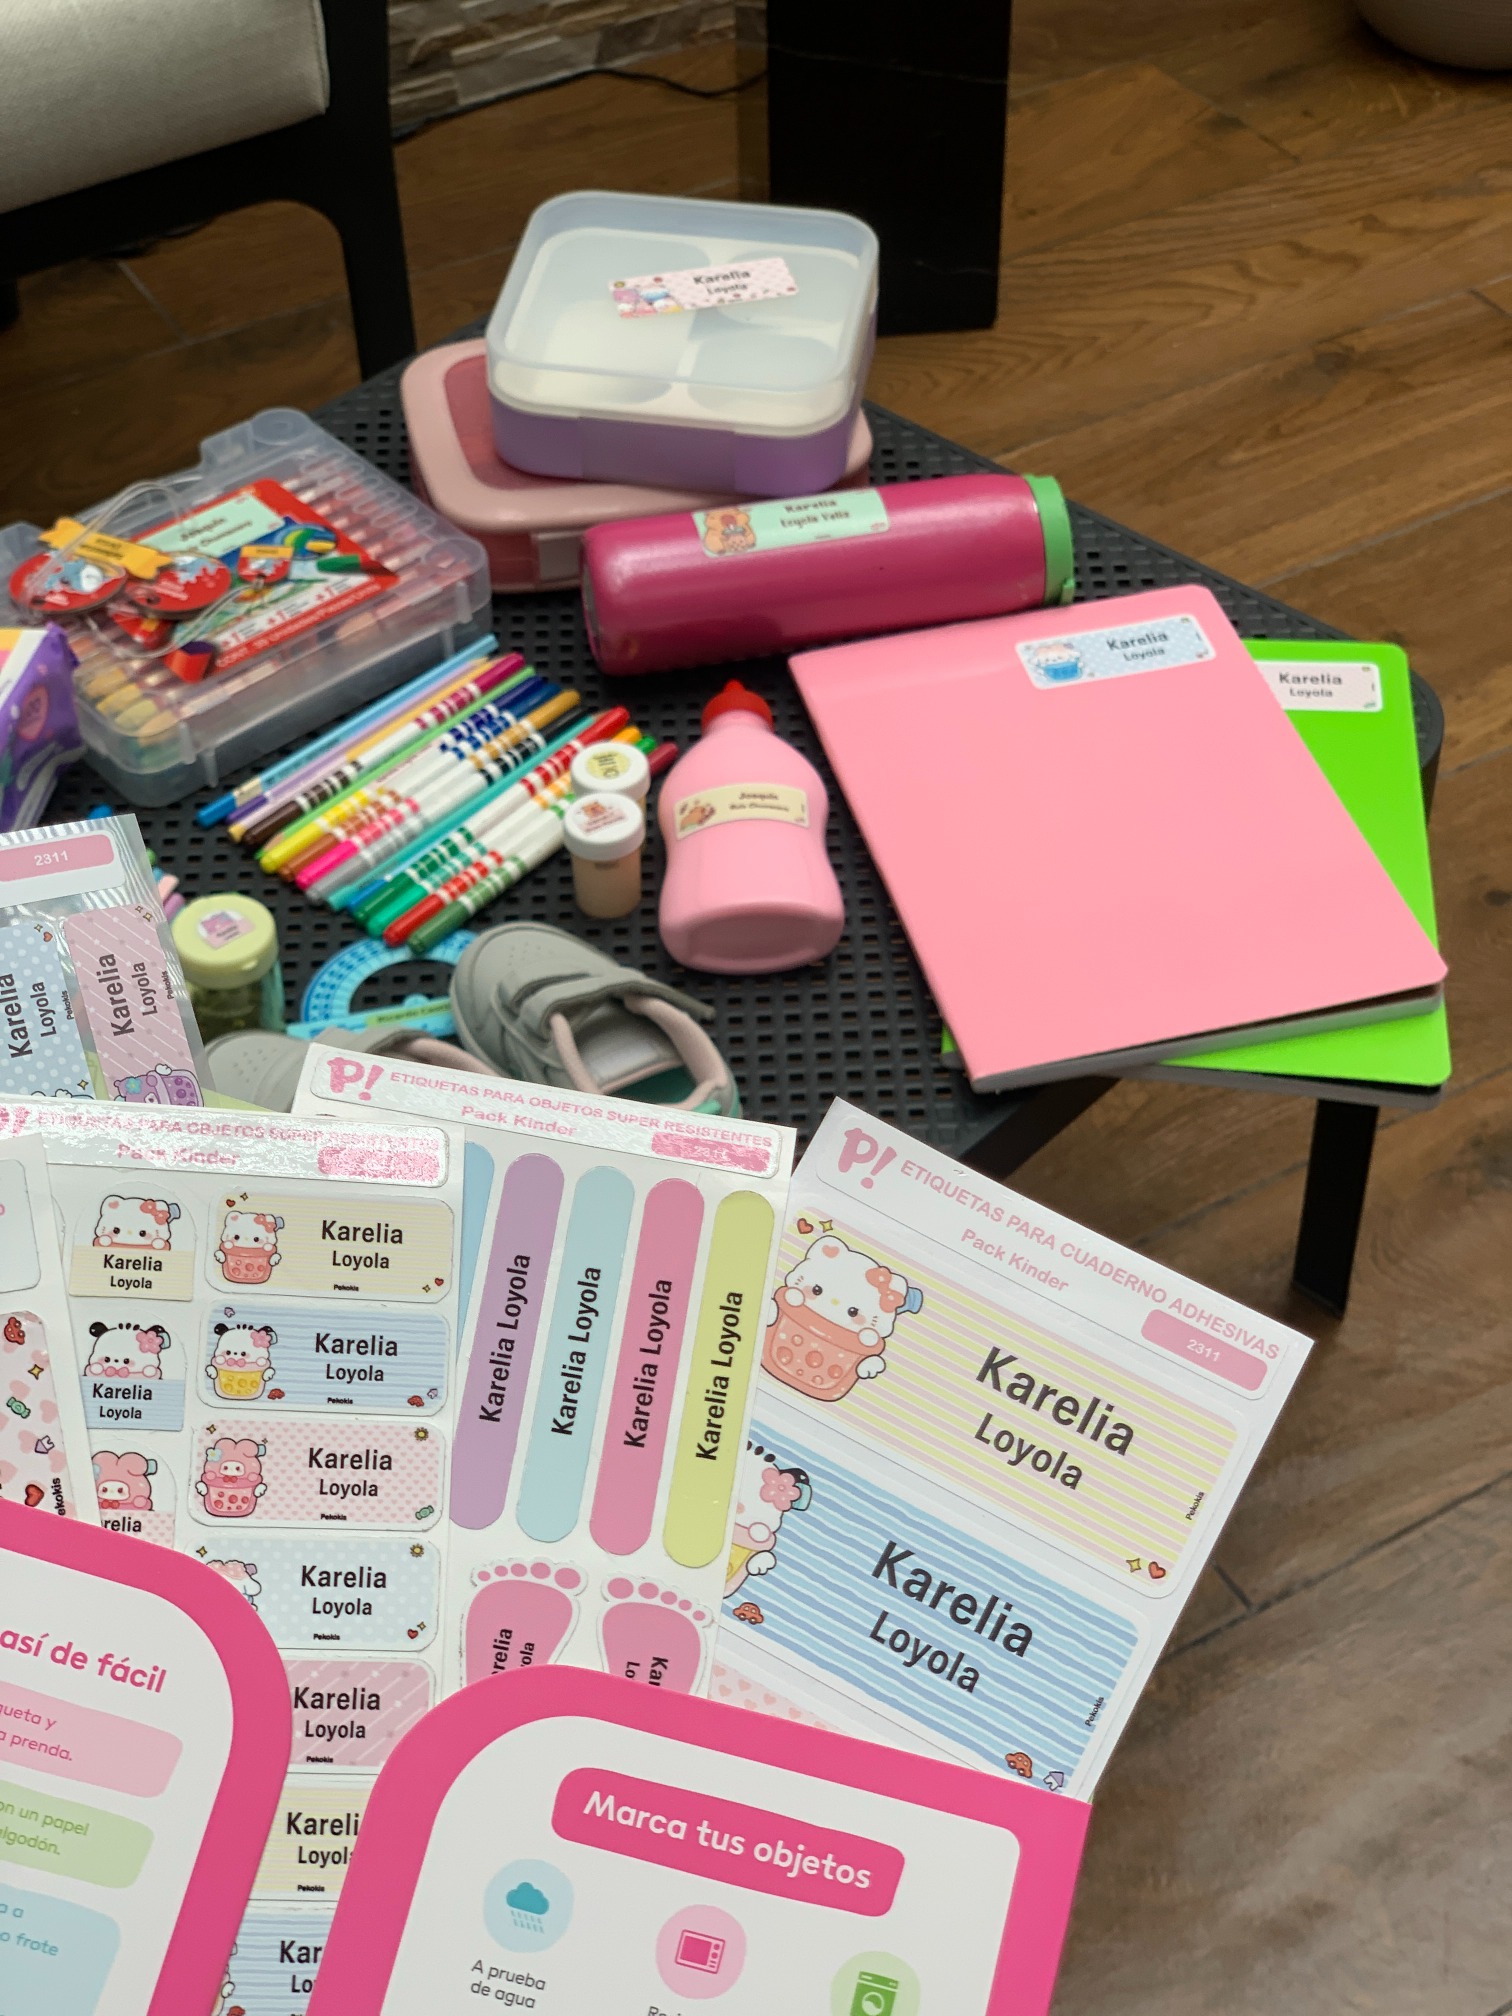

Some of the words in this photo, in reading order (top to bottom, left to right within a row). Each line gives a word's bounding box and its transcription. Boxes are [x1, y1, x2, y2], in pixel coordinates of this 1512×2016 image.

[1107, 629, 1169, 651] Karelia
[1123, 645, 1166, 662] Loyola
[1279, 671, 1343, 686] Karelia
[1289, 688, 1334, 698] Loyola
[34, 850, 69, 867] 2311
[98, 953, 135, 1037] Karelia
[131, 962, 158, 1016] Loyola
[161, 971, 175, 1000] Pekokis
[0, 974, 33, 1058] Karelia
[30, 982, 57, 1037] Loyola
[62, 990, 74, 1020] Pekokis
[390, 1071, 479, 1096] ETIQUETAS
[483, 1088, 525, 1106] PARA
[529, 1095, 603, 1118] OBJETOS
[607, 1107, 660, 1129] SUPER
[664, 1120, 773, 1147] RESISTENTES
[460, 1105, 508, 1123] Pack
[513, 1114, 578, 1137] Kinder
[187, 1121, 265, 1138] OBJETOS
[837, 1127, 898, 1190] P!
[321, 1219, 403, 1244] Karelia
[103, 1254, 163, 1272] Karelia
[332, 1250, 390, 1271] Loyola
[900, 1159, 1005, 1224] ETIQUETAS
[1006, 1214, 1057, 1251] PARA
[1059, 1242, 1168, 1305] CUADERNO
[1168, 1296, 1281, 1361] ADHESIVAS
[960, 1228, 1004, 1262] Pack
[1008, 1249, 1070, 1293] Kinder
[110, 1276, 153, 1290] Loyola
[496, 1254, 531, 1330] Loyola
[568, 1266, 602, 1343] Loyola
[639, 1279, 673, 1355] Loyola
[711, 1291, 743, 1368] Loyola
[315, 1333, 398, 1357] Karelia
[1186, 1338, 1221, 1363] 2311
[325, 1363, 384, 1383] Loyola
[478, 1337, 516, 1423] Karelia
[92, 1383, 153, 1401] Karelia
[551, 1351, 587, 1436] Karelia
[623, 1363, 659, 1448] Karelia
[975, 1346, 1135, 1457] Karelia
[99, 1405, 142, 1420] Loyola
[695, 1375, 730, 1461] Karelia
[308, 1447, 393, 1471] Karelia
[974, 1412, 1084, 1491] Loyola
[319, 1479, 379, 1498] Loyola
[1185, 1491, 1205, 1521] Pekokis
[101, 1516, 142, 1532] relia
[301, 1565, 387, 1589] Karelia
[312, 1597, 373, 1617] Loyola
[870, 1540, 1034, 1657] Karelia
[0, 1630, 49, 1657] así
[50, 1641, 88, 1670] de
[98, 1653, 167, 1693] fácil
[869, 1612, 981, 1694] Loyola
[293, 1687, 381, 1711] Karelia
[1085, 1696, 1105, 1727] Pekokis
[45, 1718, 57, 1731] y
[305, 1720, 366, 1740] Loyola
[10, 1734, 72, 1761] prenda.
[19, 1807, 39, 1821] un
[41, 1814, 90, 1836] papel
[583, 1790, 687, 1840] Marca
[696, 1818, 745, 1856] tus
[753, 1838, 872, 1890] objetos
[12, 1907, 24, 1919] a
[16, 1933, 59, 1957] frote
[291, 1975, 317, 1993] Lo
[471, 1959, 485, 1975] A
[487, 1967, 547, 1991] prueba
[470, 1979, 493, 1997] de
[495, 1986, 537, 2010] agua
